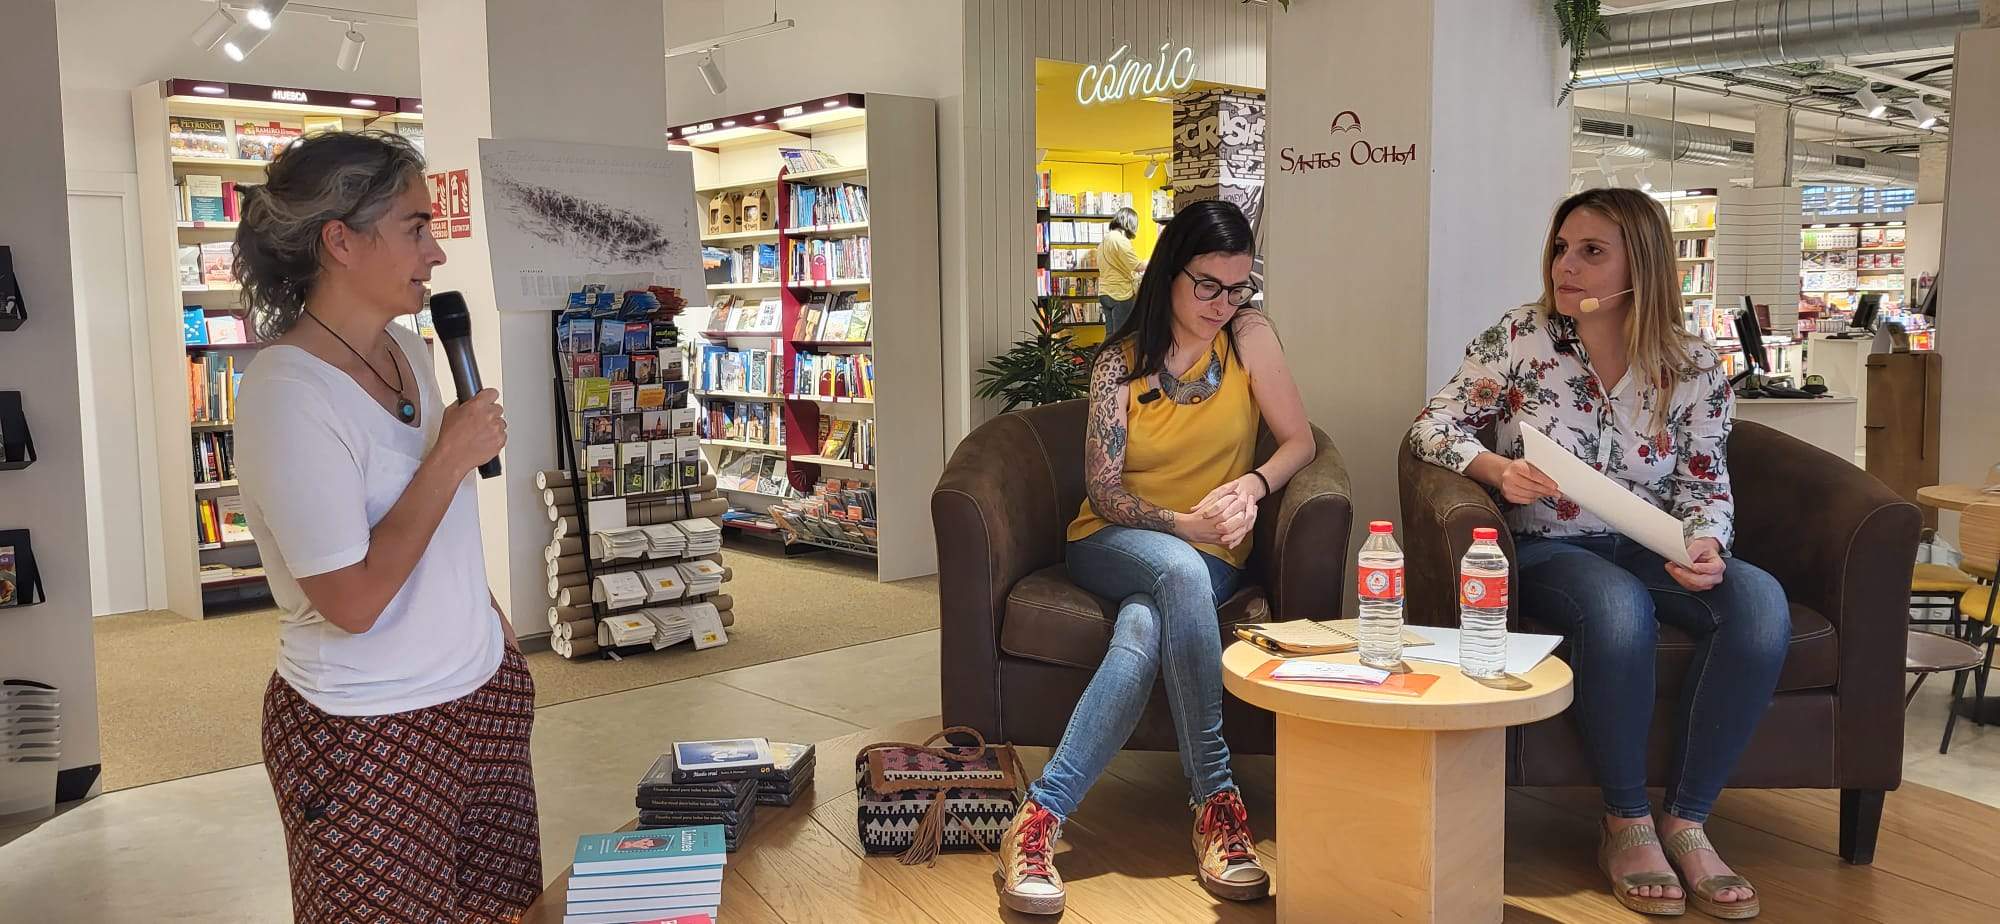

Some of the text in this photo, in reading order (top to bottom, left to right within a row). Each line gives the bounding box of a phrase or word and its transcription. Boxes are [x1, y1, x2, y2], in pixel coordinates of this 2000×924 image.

[1077, 42, 1196, 105] cómic
[271, 89, 308, 102] HUESCA
[180, 120, 223, 130] PETRONILA
